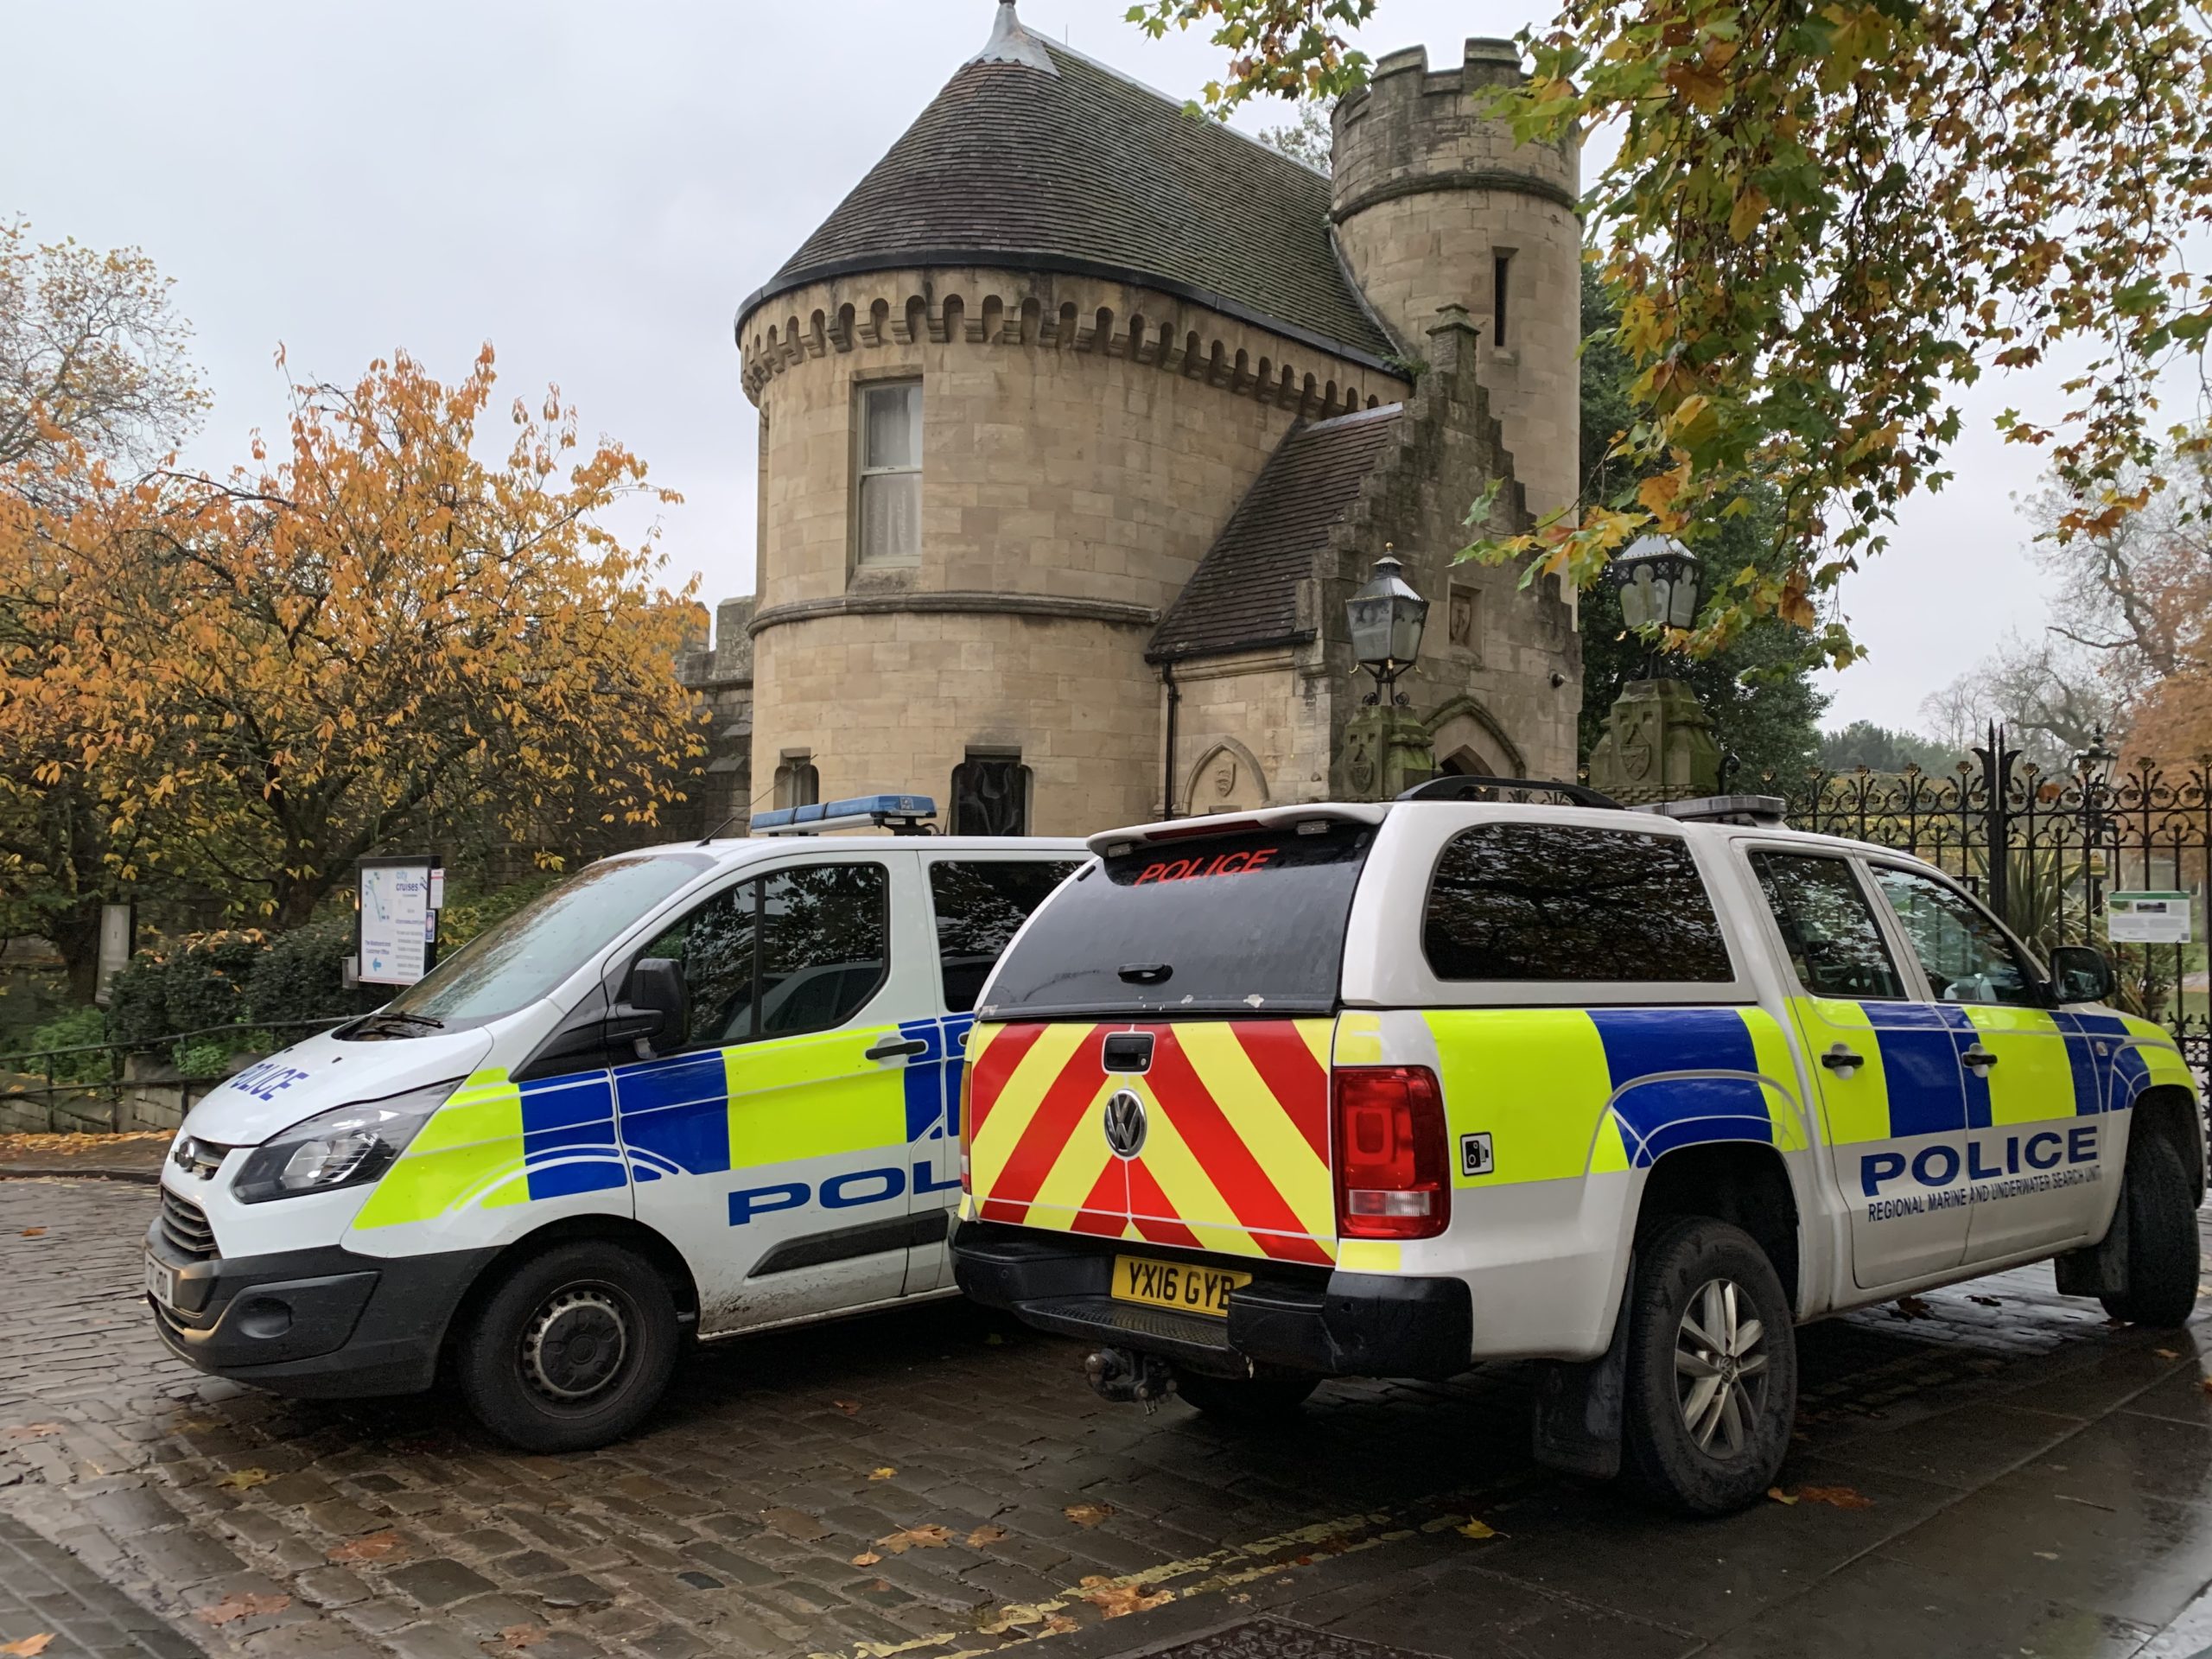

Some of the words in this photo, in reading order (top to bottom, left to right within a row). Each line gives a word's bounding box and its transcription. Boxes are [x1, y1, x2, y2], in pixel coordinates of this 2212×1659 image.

[396, 882, 419, 892] cruises
[1134, 849, 1278, 888] POLICE
[1860, 1126, 2098, 1197] POLICE
[1868, 1195, 1925, 1222] REGIONAL
[1928, 1188, 1967, 1211] MARINE
[1969, 1184, 1989, 1204] AND
[1991, 1174, 2050, 1200] UNDERWATER
[2052, 1168, 2084, 1189] SEARCH
[2085, 1164, 2101, 1183] UNIT
[1128, 1262, 1179, 1301] YX16
[1185, 1271, 1235, 1310] GYB
